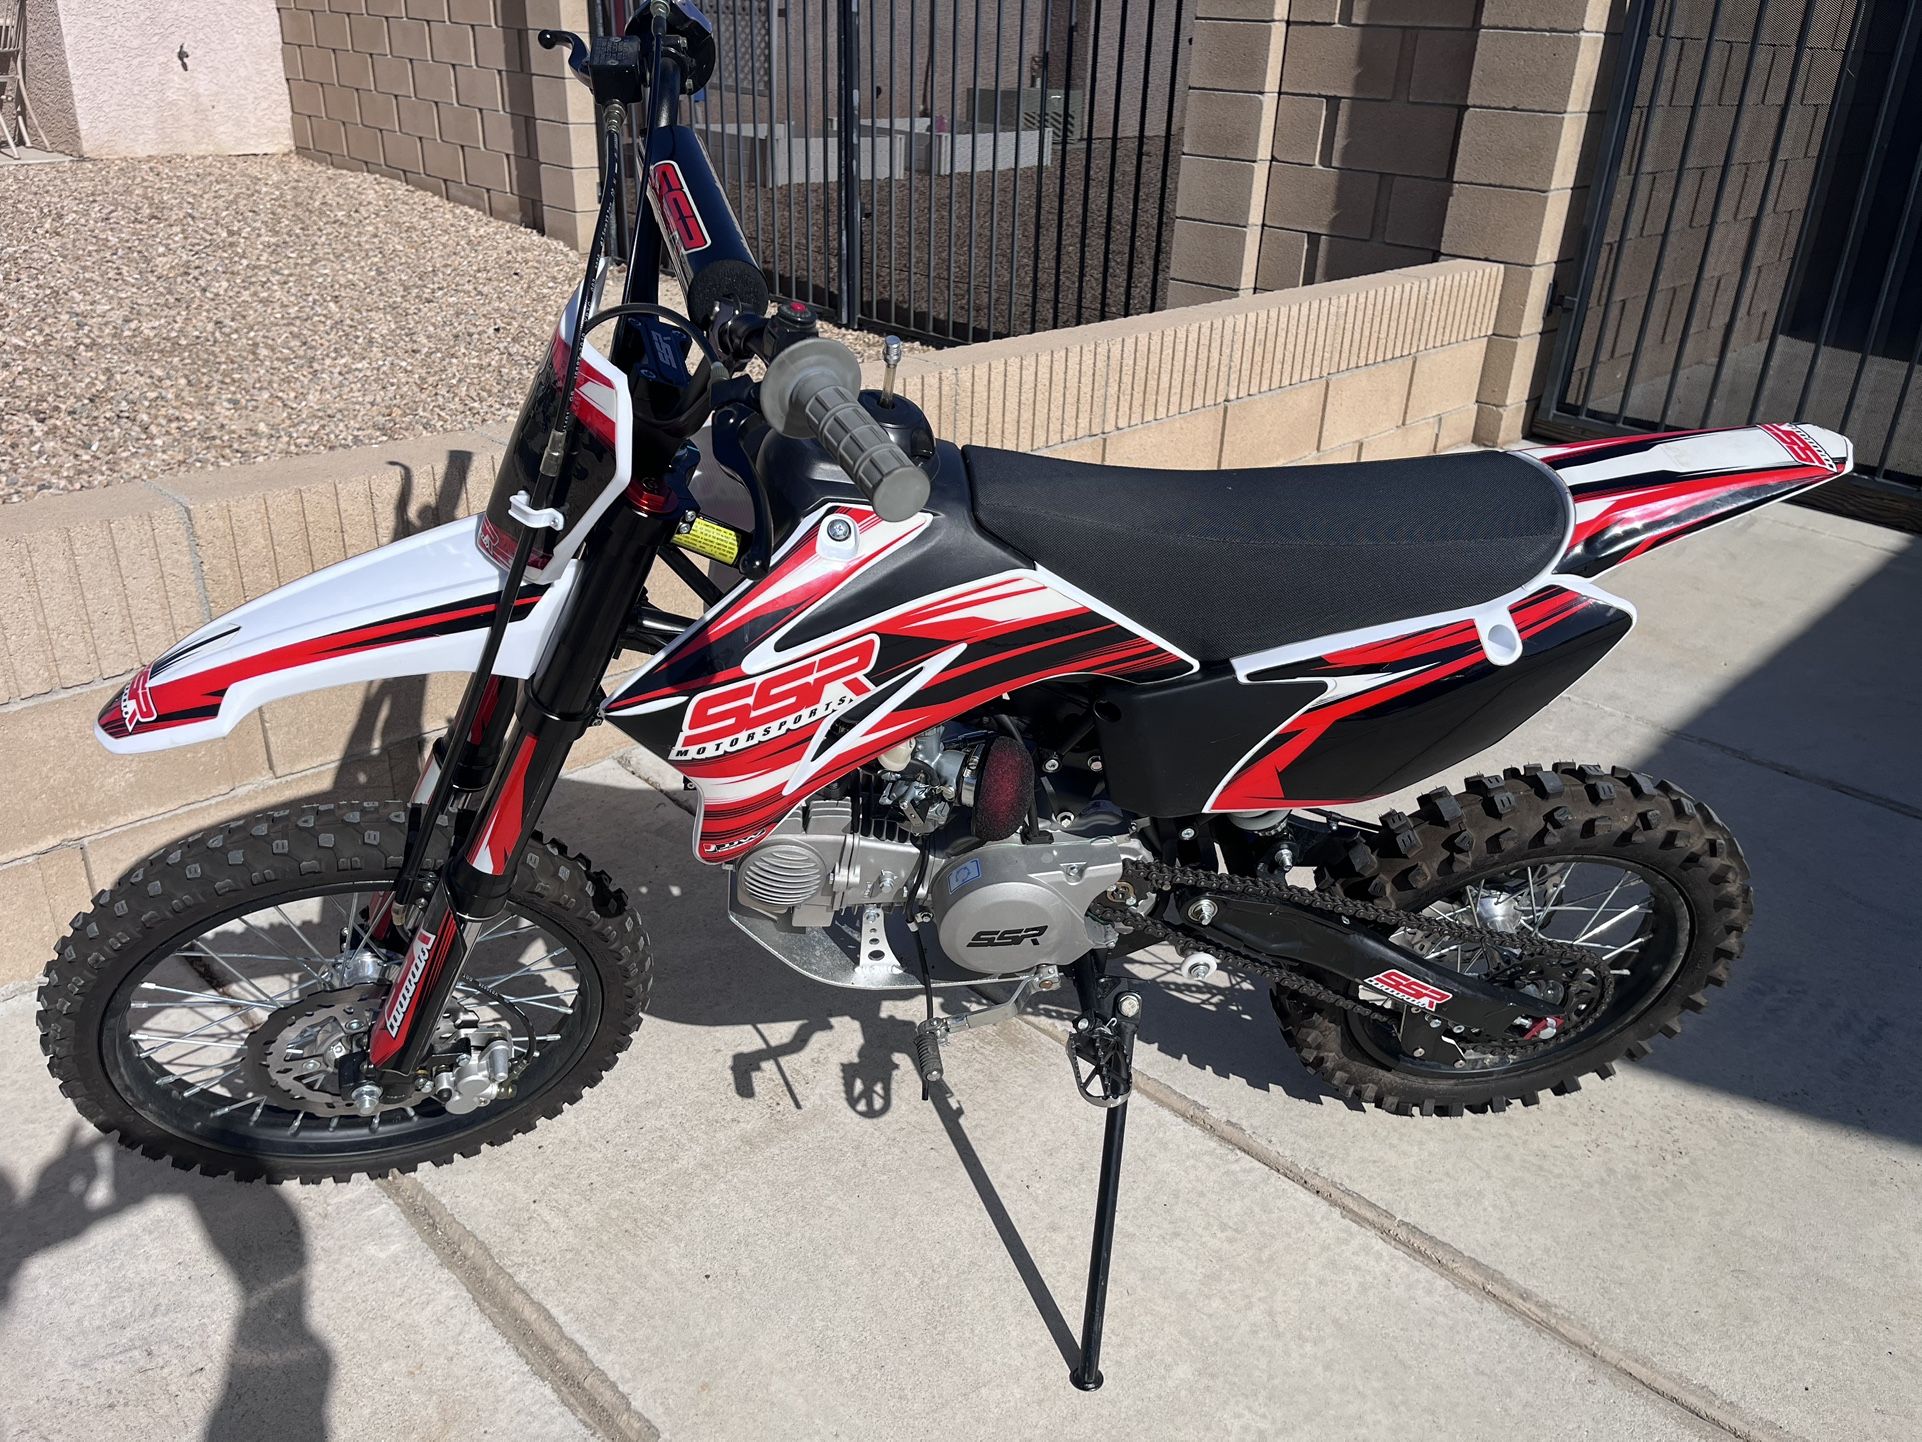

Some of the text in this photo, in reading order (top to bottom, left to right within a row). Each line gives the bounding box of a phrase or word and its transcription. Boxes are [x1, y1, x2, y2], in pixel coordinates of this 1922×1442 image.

[681, 638, 872, 747] SSR
[675, 695, 848, 758] MOTORSPORTS
[966, 924, 1049, 948] SSR
[1374, 971, 1452, 1009] SSR
